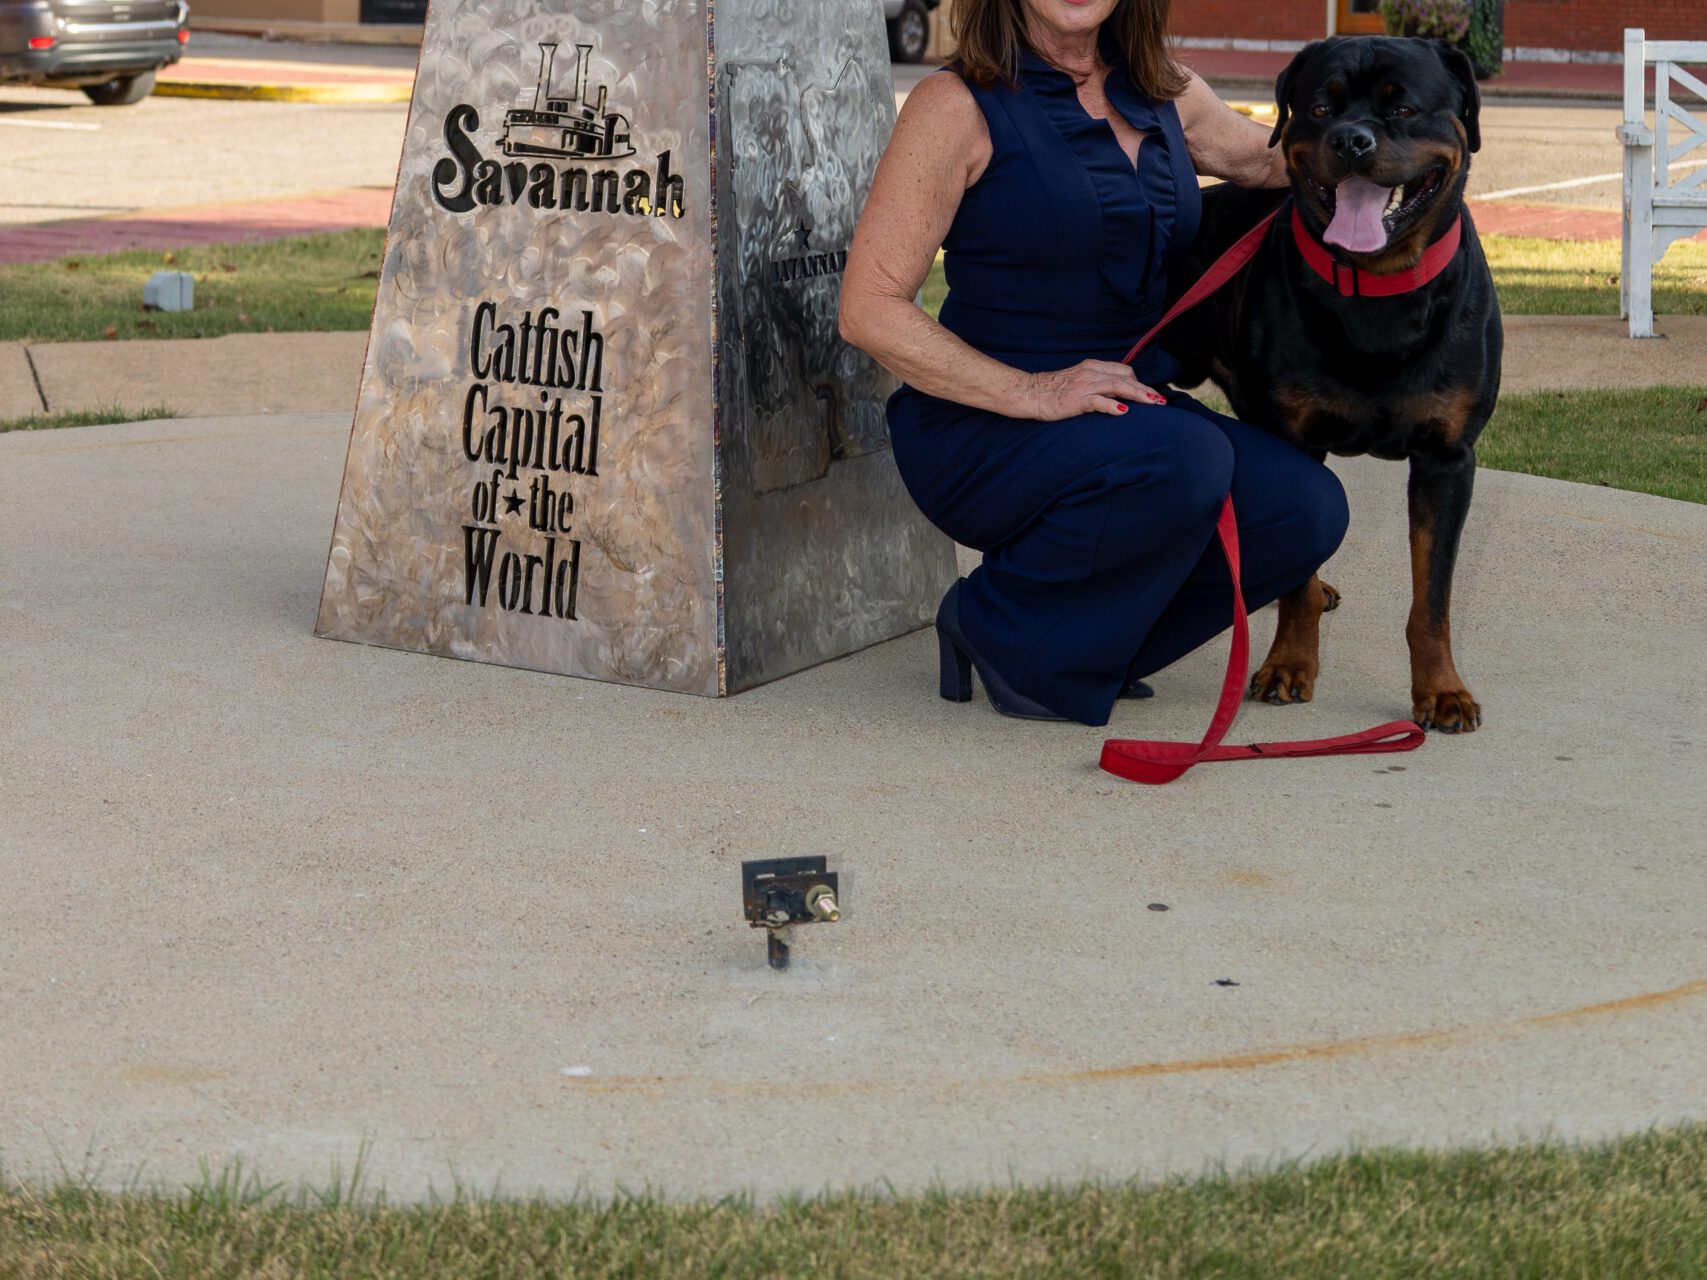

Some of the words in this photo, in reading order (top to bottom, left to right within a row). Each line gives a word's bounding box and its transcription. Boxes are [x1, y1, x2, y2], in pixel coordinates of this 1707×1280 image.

[431, 103, 686, 219] Savannah
[470, 301, 604, 393] Catfish
[463, 383, 602, 481] Capital
[471, 468, 505, 524] of
[529, 474, 574, 534] the
[461, 525, 581, 621] World
